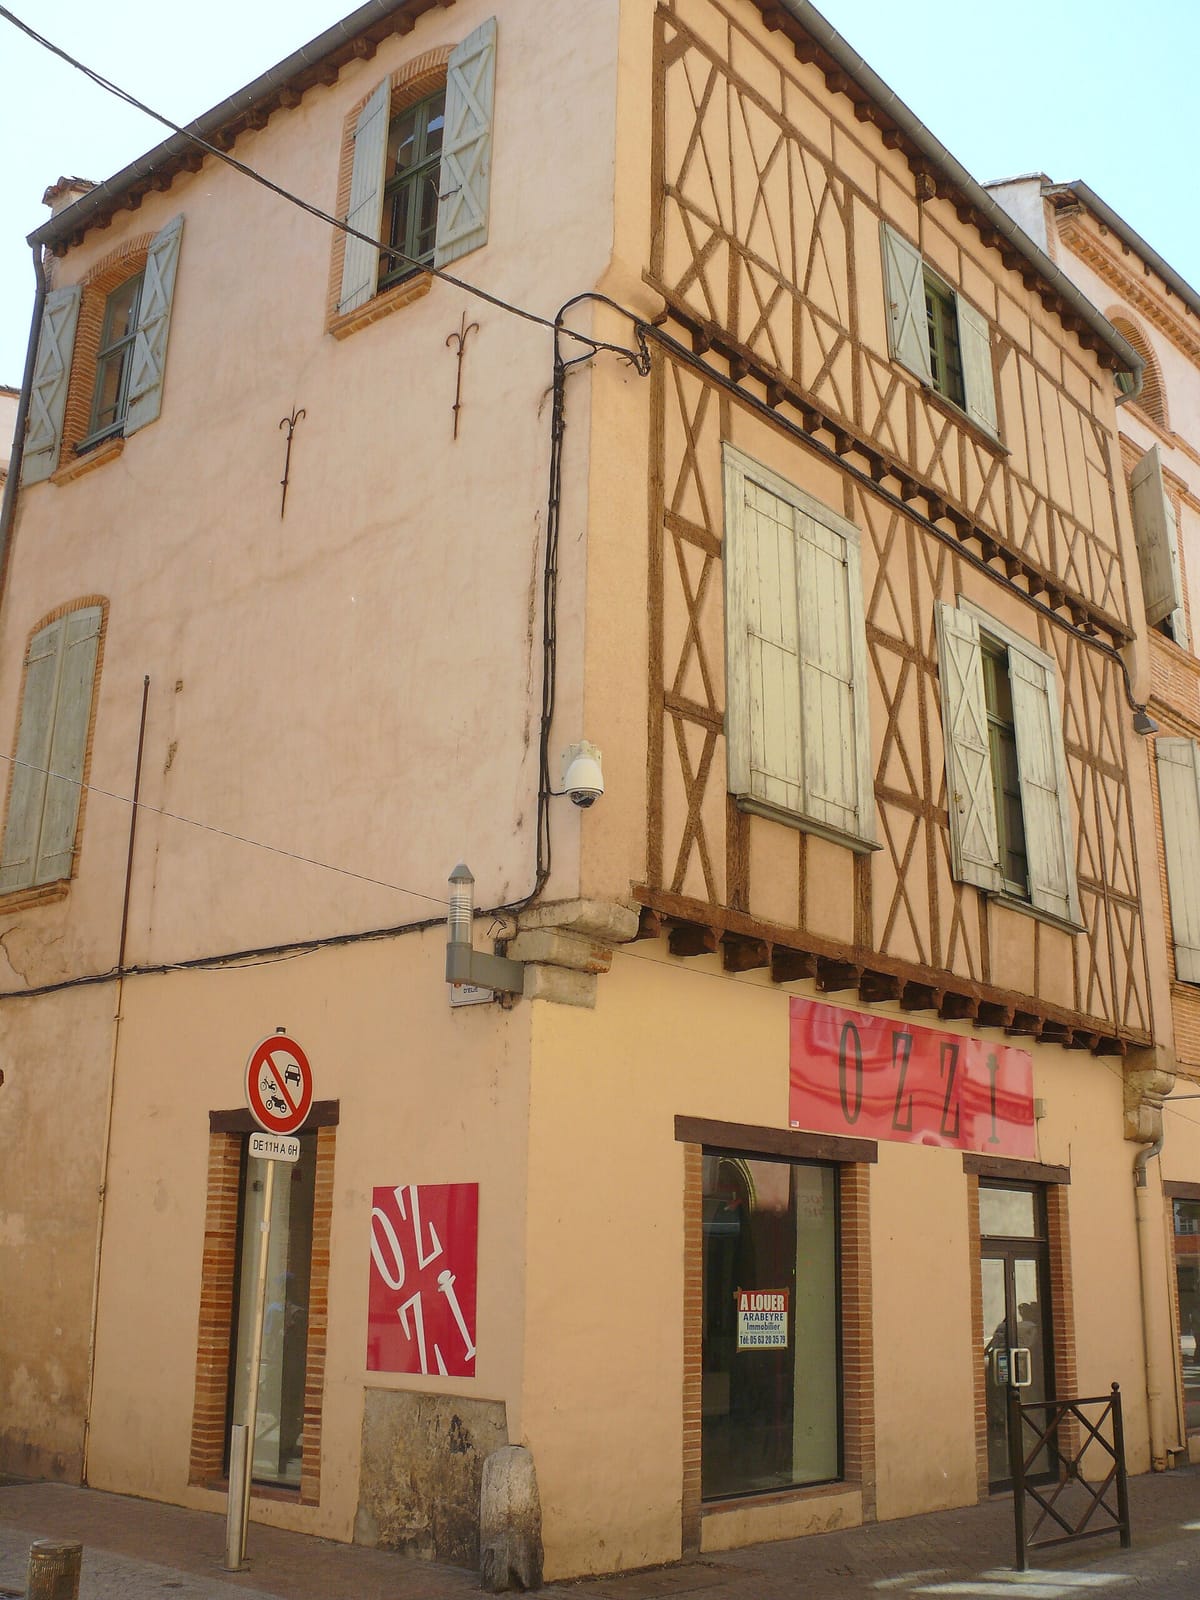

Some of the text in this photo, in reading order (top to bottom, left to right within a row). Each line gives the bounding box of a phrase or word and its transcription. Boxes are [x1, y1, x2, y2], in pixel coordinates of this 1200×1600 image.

[838, 1020, 1001, 1145] OZZI
[280, 1143, 286, 1154] A
[288, 1144, 298, 1156] 6H
[740, 1294, 785, 1311] A LOUER
[743, 1313, 784, 1321] ARABEYRE
[747, 1322, 780, 1331] Immobilier
[750, 1335, 757, 1345] 05
